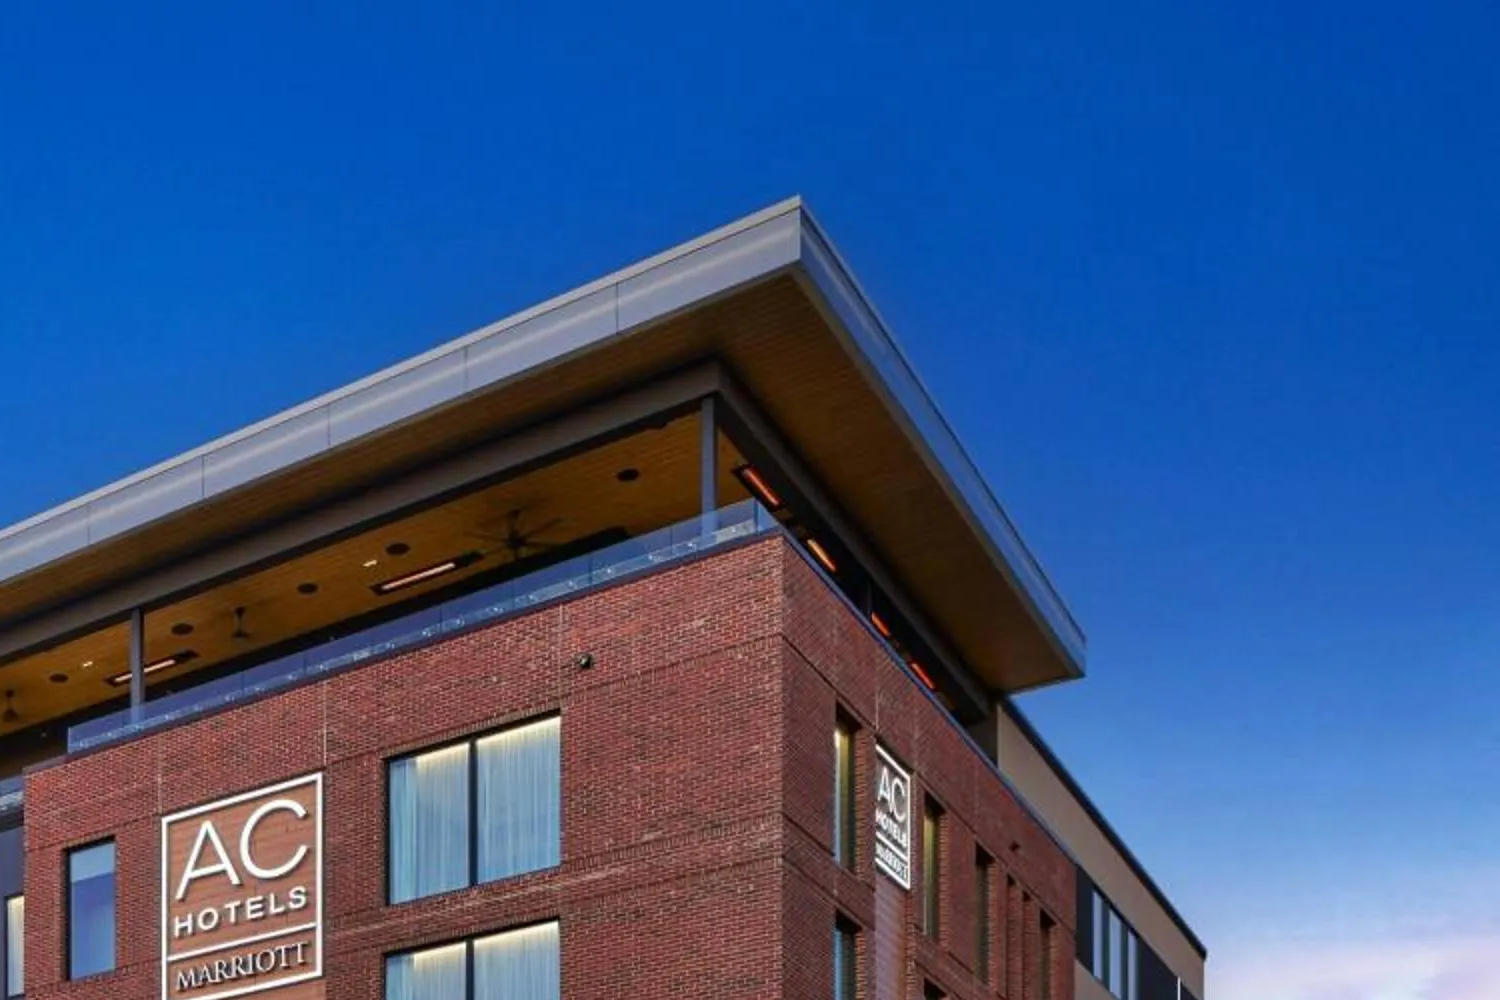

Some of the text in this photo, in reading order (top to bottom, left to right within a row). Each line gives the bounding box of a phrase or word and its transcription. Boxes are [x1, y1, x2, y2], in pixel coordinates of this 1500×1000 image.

[877, 765, 907, 823] AC
[175, 798, 309, 900] AC
[173, 885, 308, 938] HOTELS
[175, 940, 309, 992] MARRIOTT
